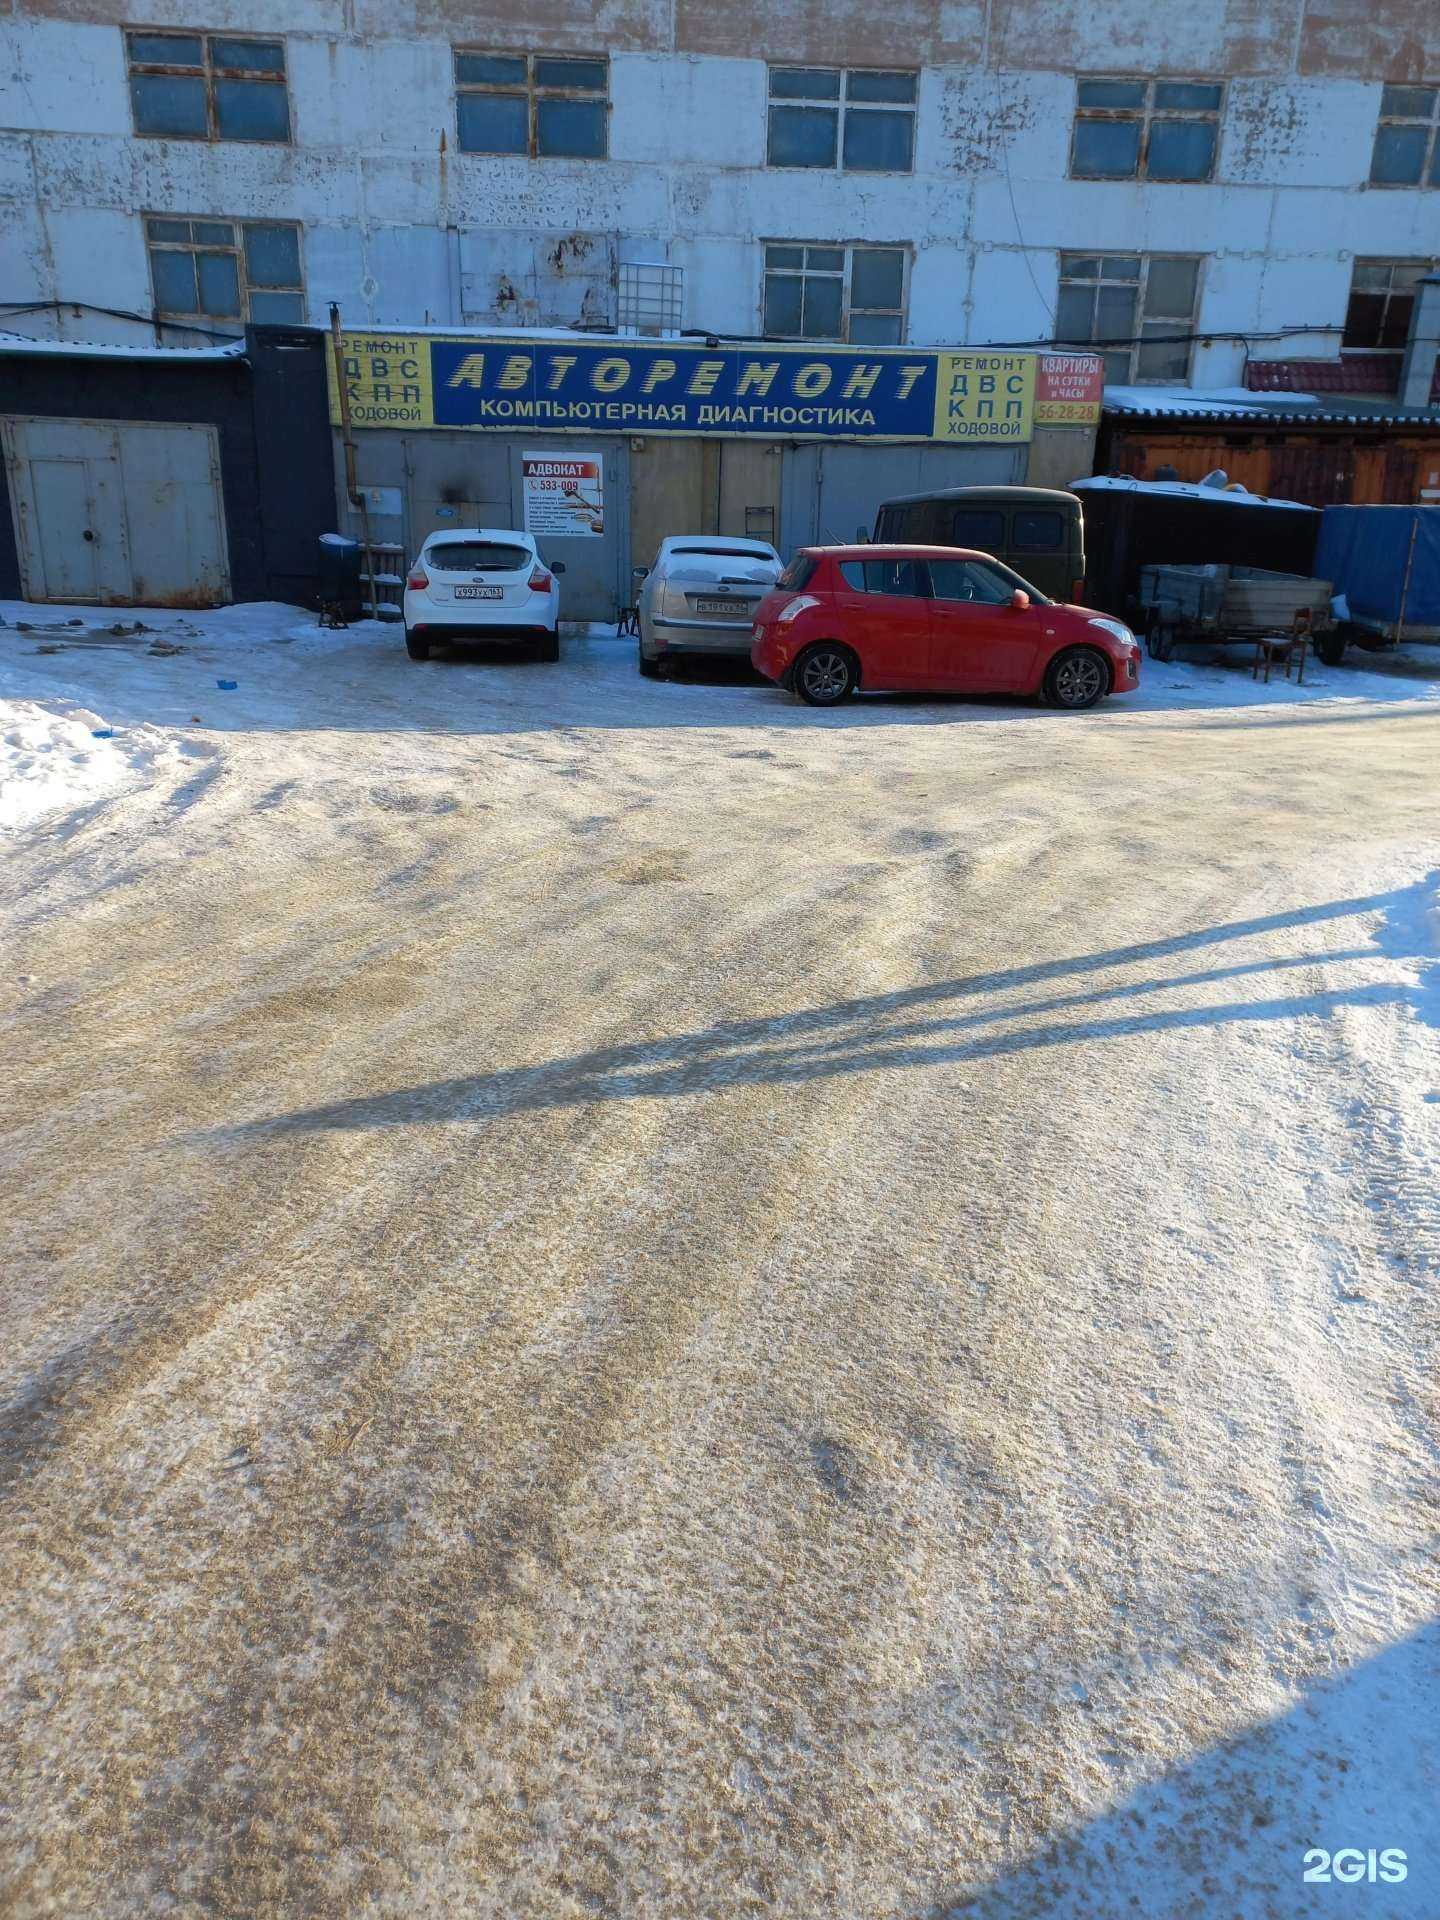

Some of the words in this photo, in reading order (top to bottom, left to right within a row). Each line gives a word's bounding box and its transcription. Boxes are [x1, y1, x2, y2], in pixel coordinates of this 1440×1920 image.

[341, 340, 418, 355] РЕМОНТ
[343, 357, 419, 380] ДВС
[951, 358, 1026, 371] РЕМОНТ
[1041, 357, 1100, 374] КВАРТИРЫ
[445, 353, 928, 400] АВТОРЕМОНТ
[1047, 375, 1060, 386] НА
[1062, 375, 1091, 387] СУТКИ
[950, 374, 1025, 396] ДВС
[1059, 387, 1085, 399] ЧАСЫ
[479, 399, 687, 422] КОМПЬЮТЕРНАЯ
[697, 404, 876, 426] ДИАГНОСТИКА
[948, 399, 1023, 419] КПП
[1038, 404, 1095, 420] 56-28-28
[947, 420, 1021, 437] ХОДОВОЙ
[528, 463, 585, 477] АДВОКАТ
[540, 479, 579, 491] 533-009
